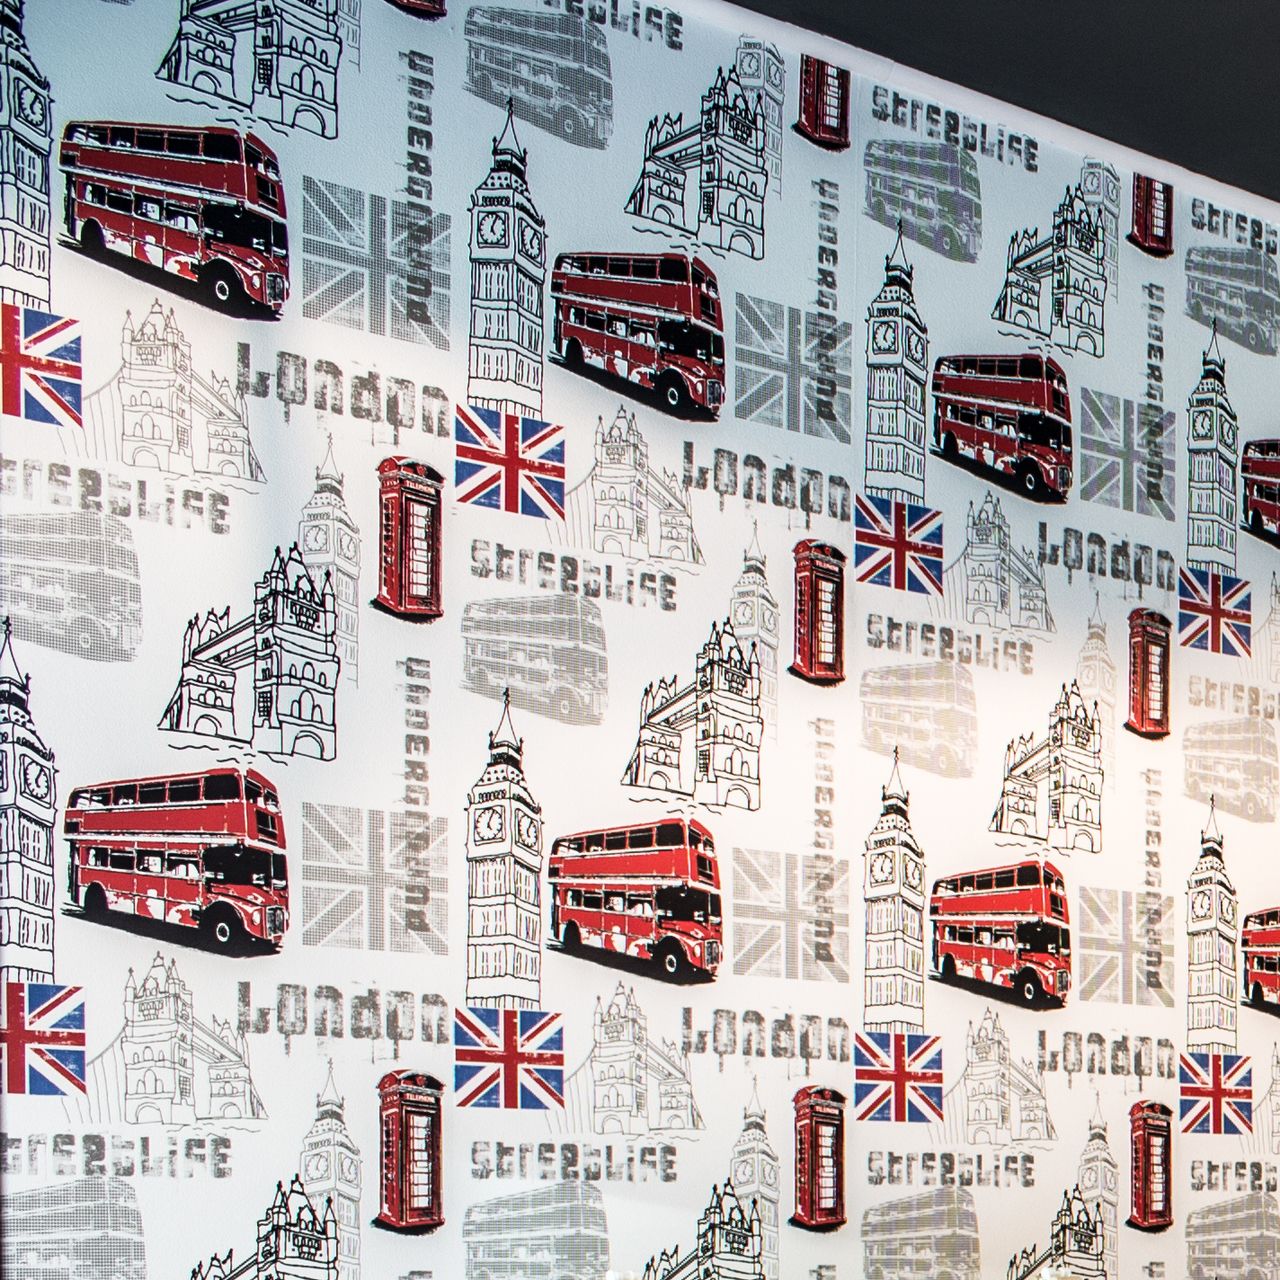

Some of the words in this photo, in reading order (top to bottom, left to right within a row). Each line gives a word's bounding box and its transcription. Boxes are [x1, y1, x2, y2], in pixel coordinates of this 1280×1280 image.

[237, 340, 450, 438] London
[681, 440, 851, 522] London
[1037, 520, 1175, 592] London
[236, 979, 449, 1043] London
[680, 1007, 849, 1062] London
[1037, 1030, 1175, 1079] London
